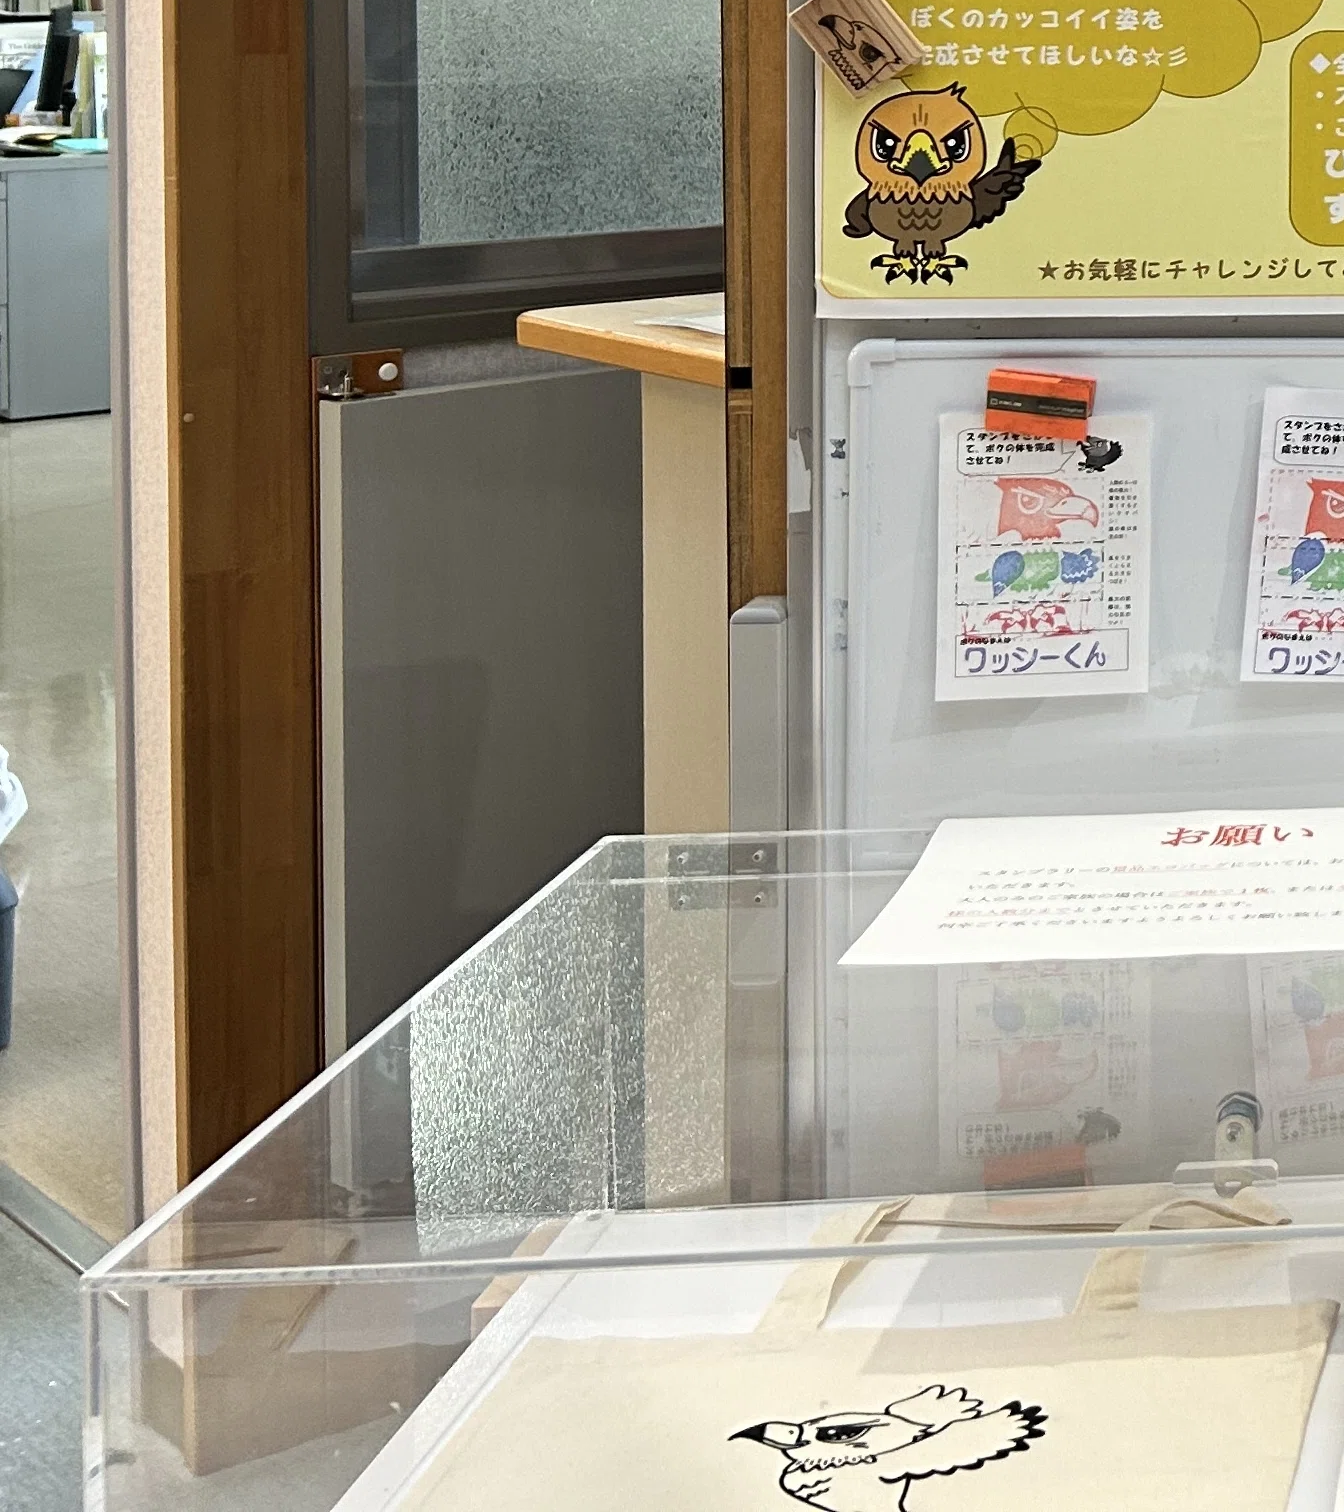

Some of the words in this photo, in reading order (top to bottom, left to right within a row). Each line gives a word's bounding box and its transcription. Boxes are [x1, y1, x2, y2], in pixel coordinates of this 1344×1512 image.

[911, 7, 1165, 31] ぼくのカッコイイ姿を
[964, 641, 1107, 674] ワッシーくん
[1161, 823, 1315, 848] お願い
